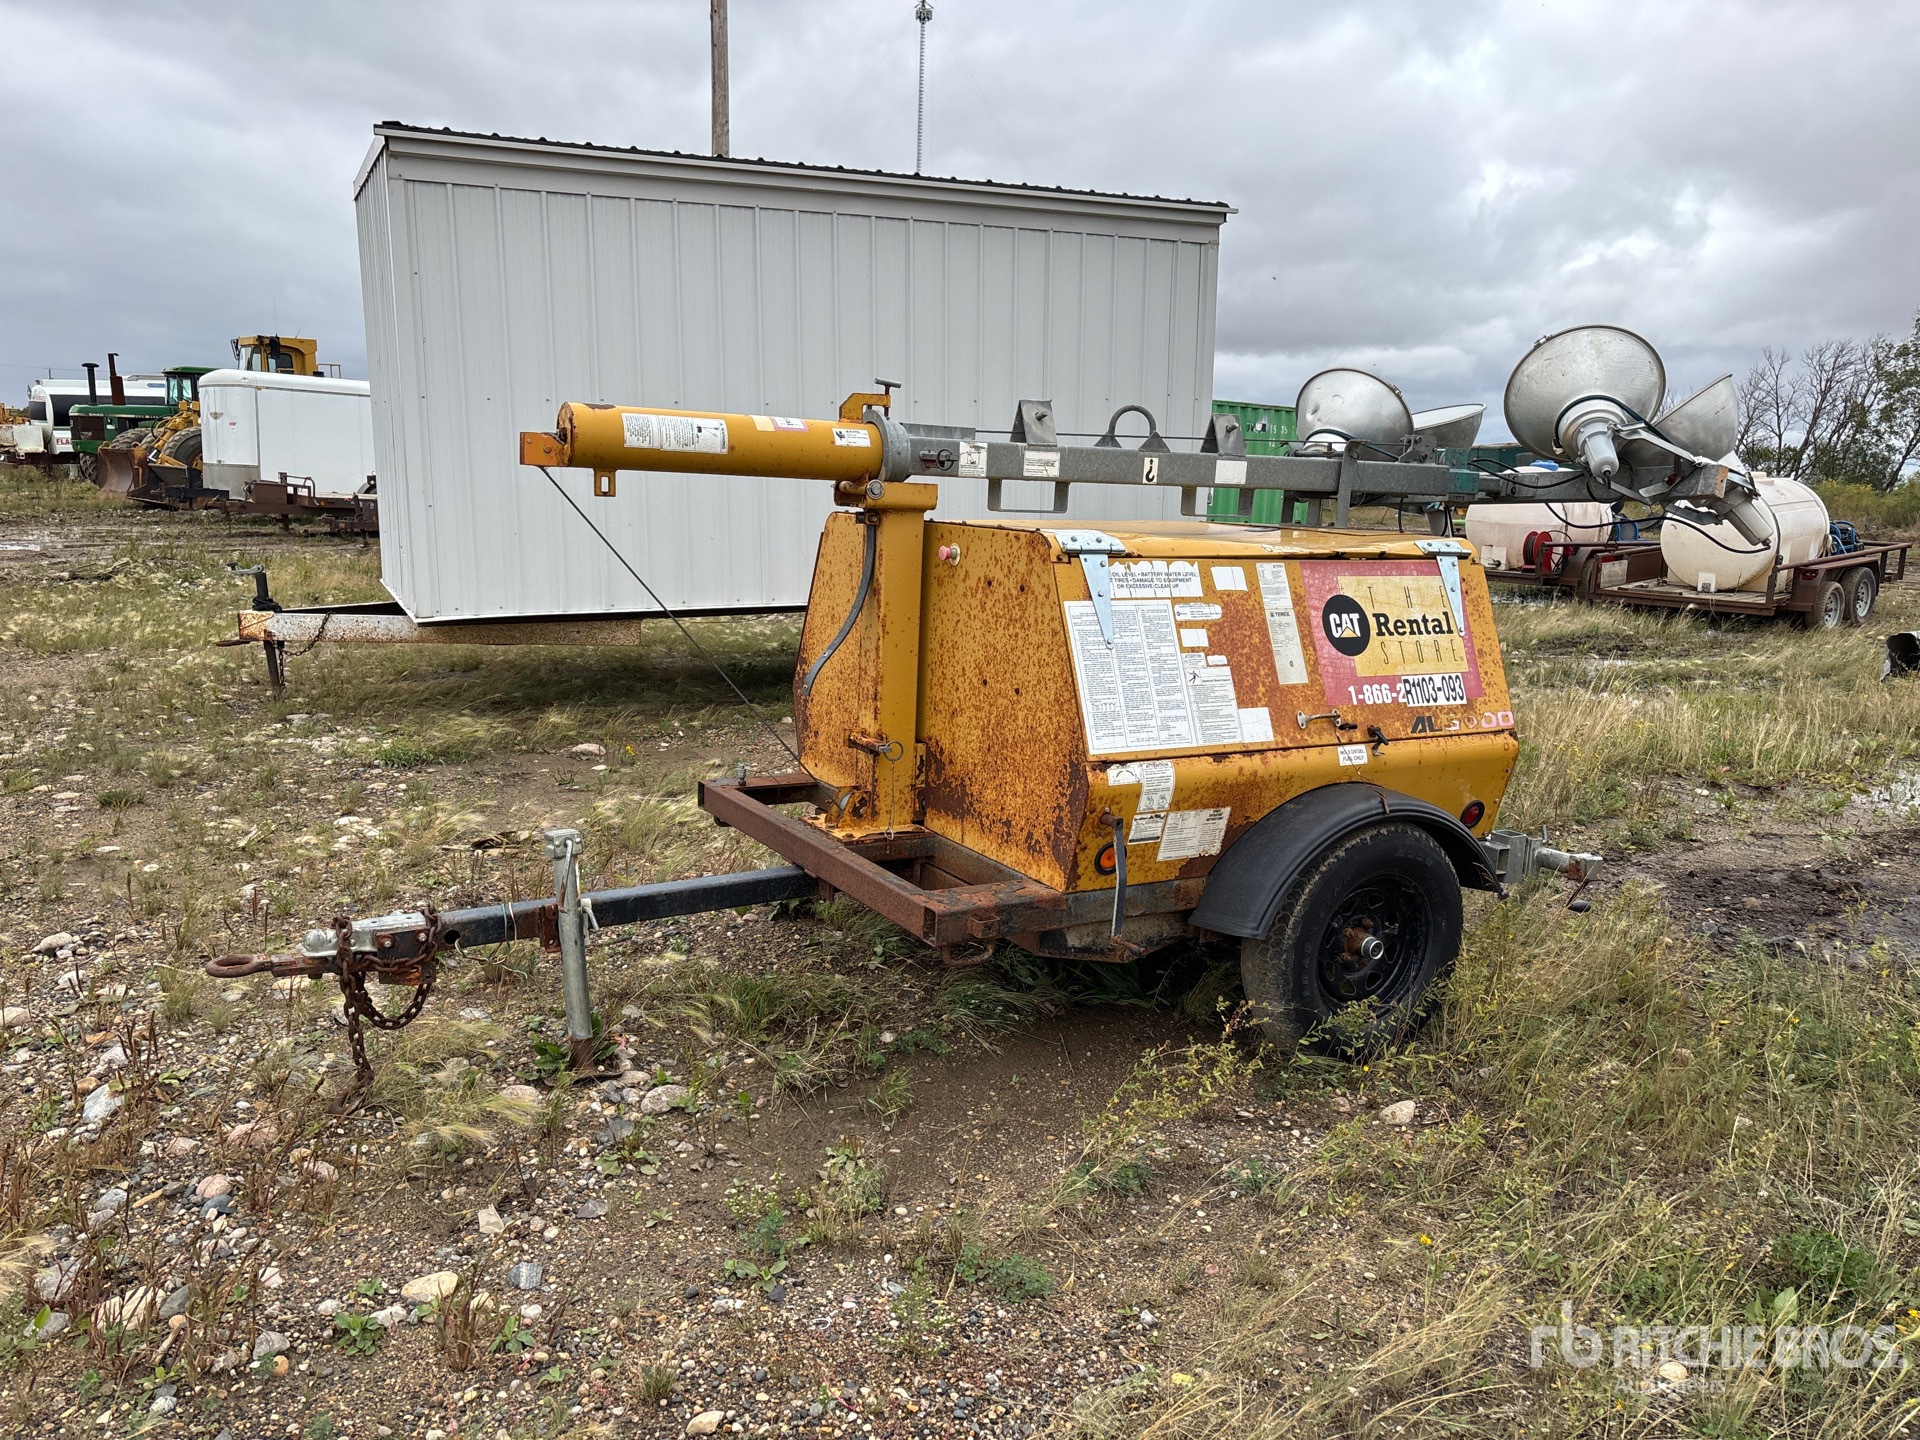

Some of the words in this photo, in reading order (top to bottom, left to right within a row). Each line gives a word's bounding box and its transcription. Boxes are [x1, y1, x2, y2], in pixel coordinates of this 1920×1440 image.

[1367, 585, 1447, 610] THE
[1329, 613, 1361, 638] CAT
[1372, 611, 1455, 637] Rental
[1380, 639, 1458, 665] STORE
[1402, 675, 1465, 706] R1103-093
